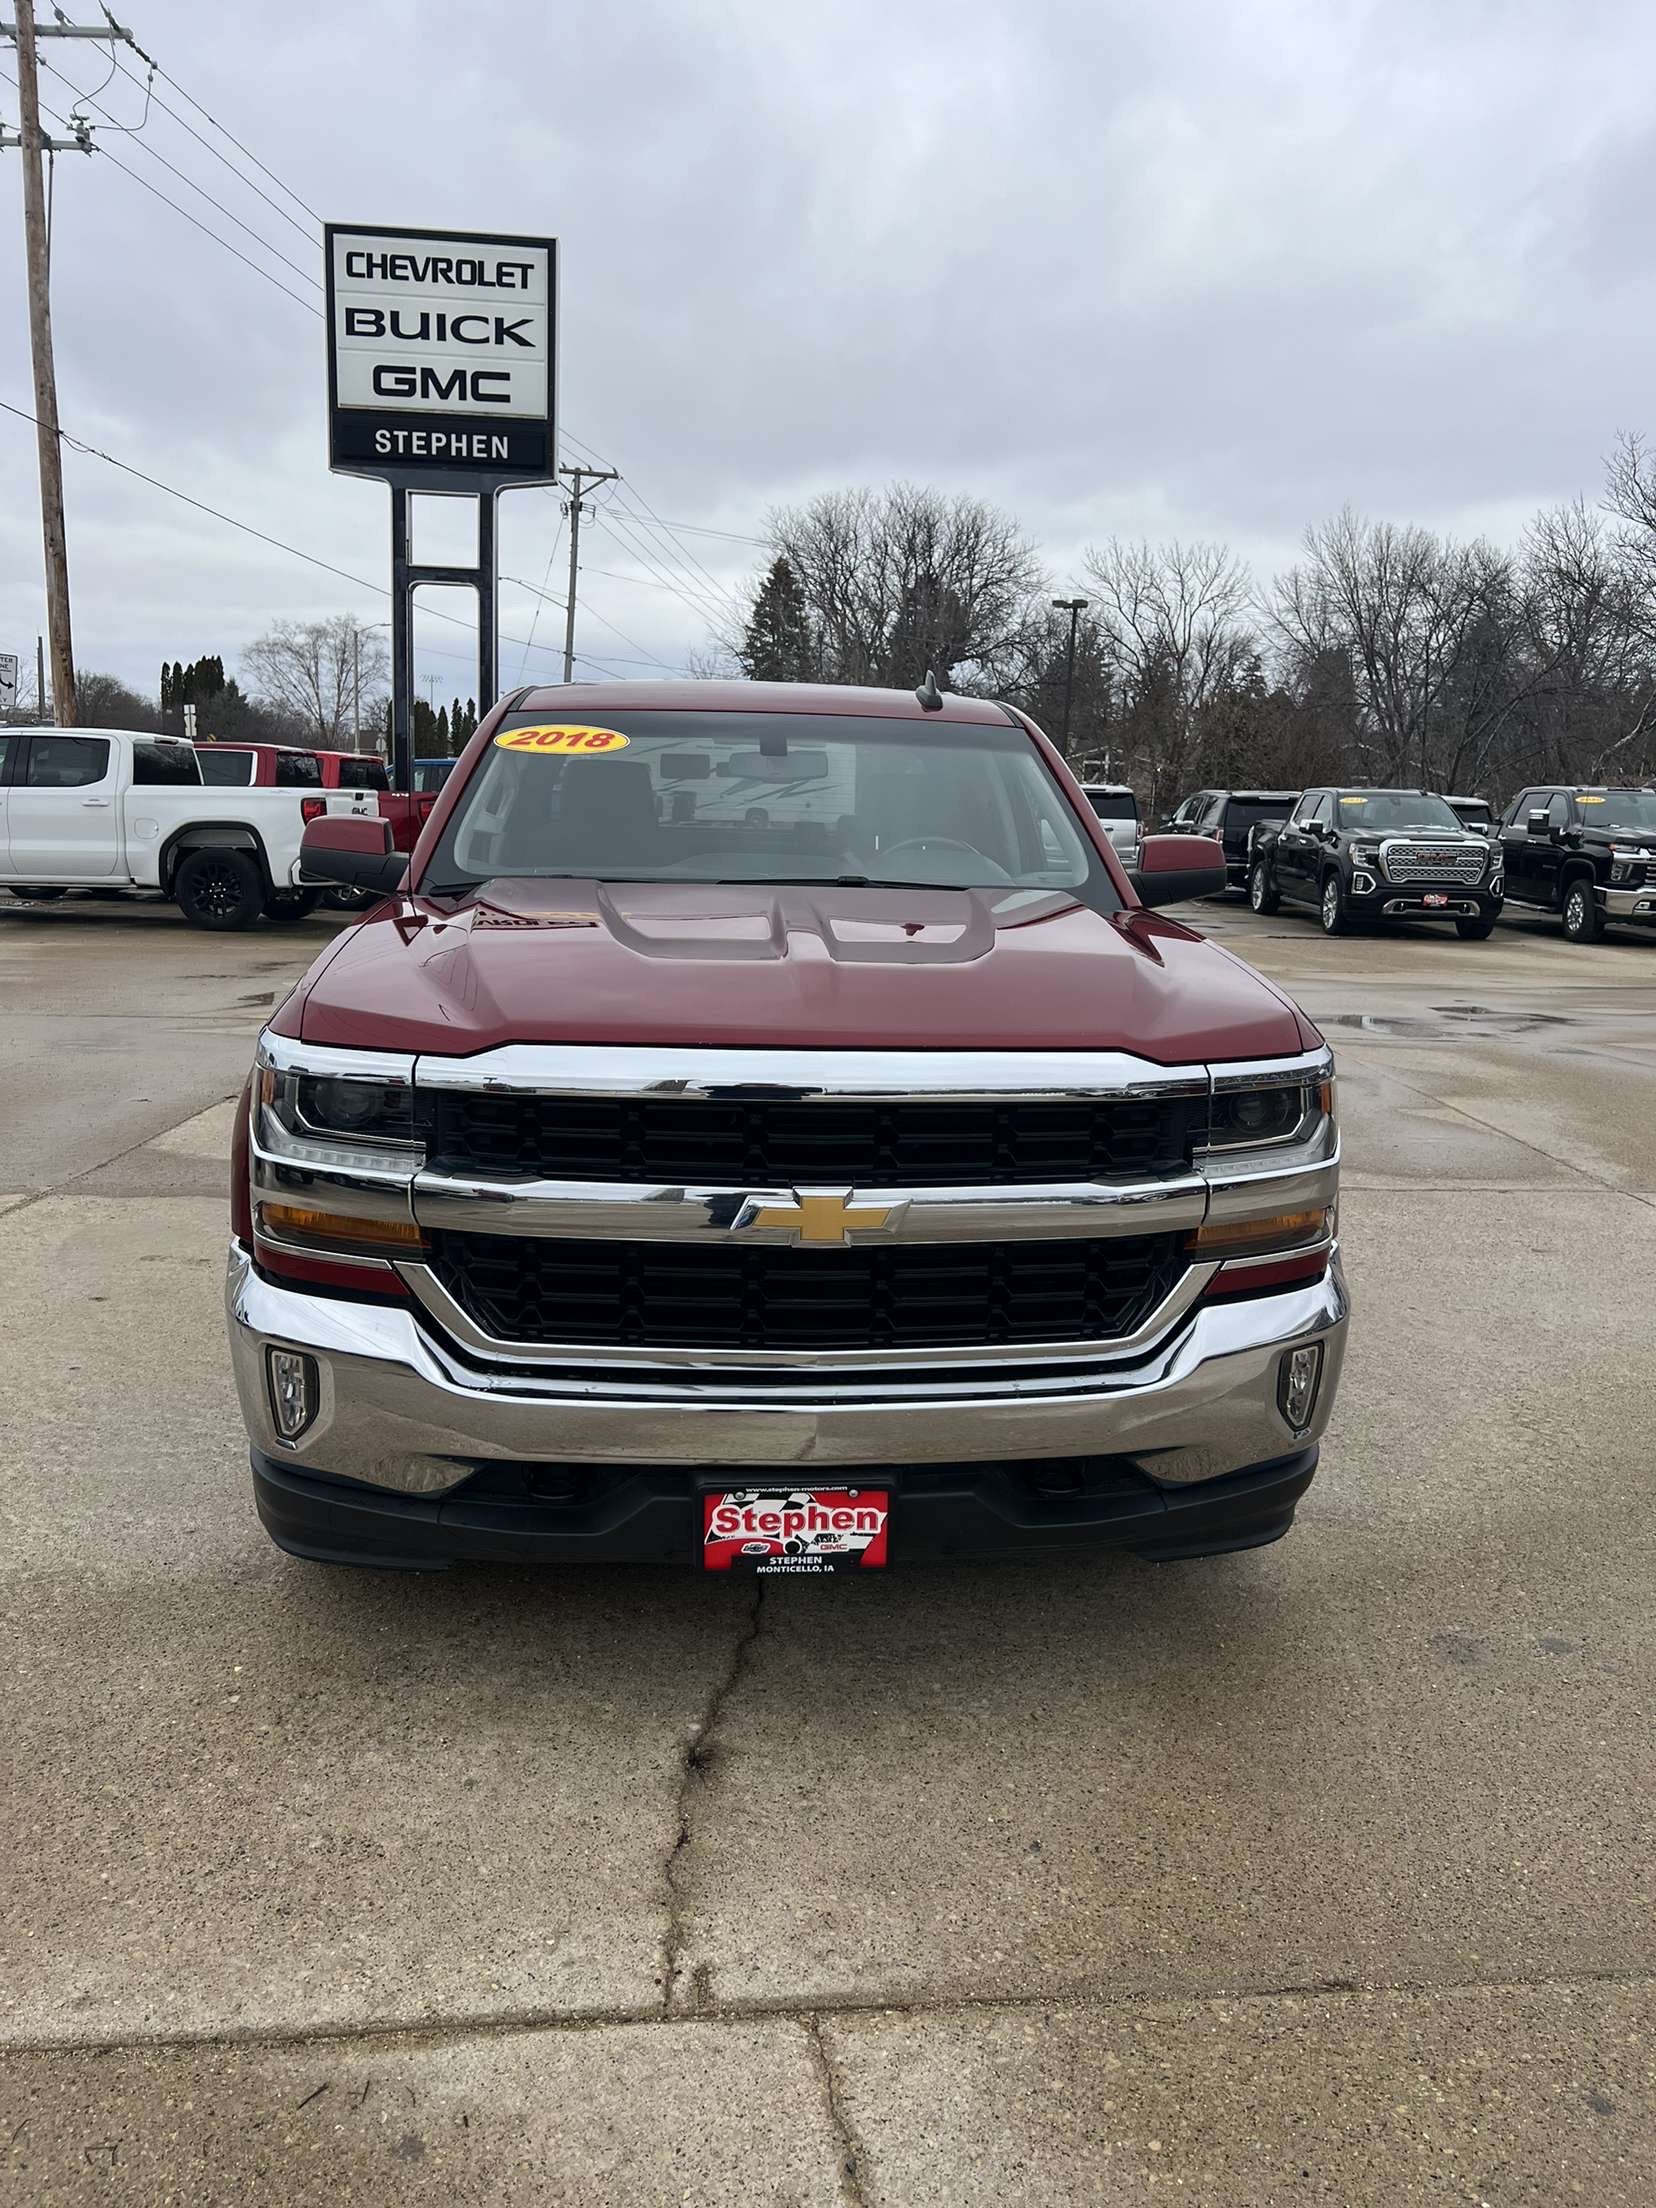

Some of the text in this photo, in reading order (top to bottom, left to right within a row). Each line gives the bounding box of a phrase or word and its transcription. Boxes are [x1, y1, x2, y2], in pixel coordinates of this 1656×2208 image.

[346, 251, 534, 289] CHEVROLET
[345, 307, 536, 347] BUICK
[372, 364, 511, 403] GMC
[374, 428, 509, 459] STEPHEN
[506, 731, 616, 748] 2018
[715, 1506, 879, 1538] Stephen
[769, 1556, 823, 1565] STEPHEN
[820, 1543, 848, 1551] GMC
[756, 1565, 823, 1574] MONTICELLO,
